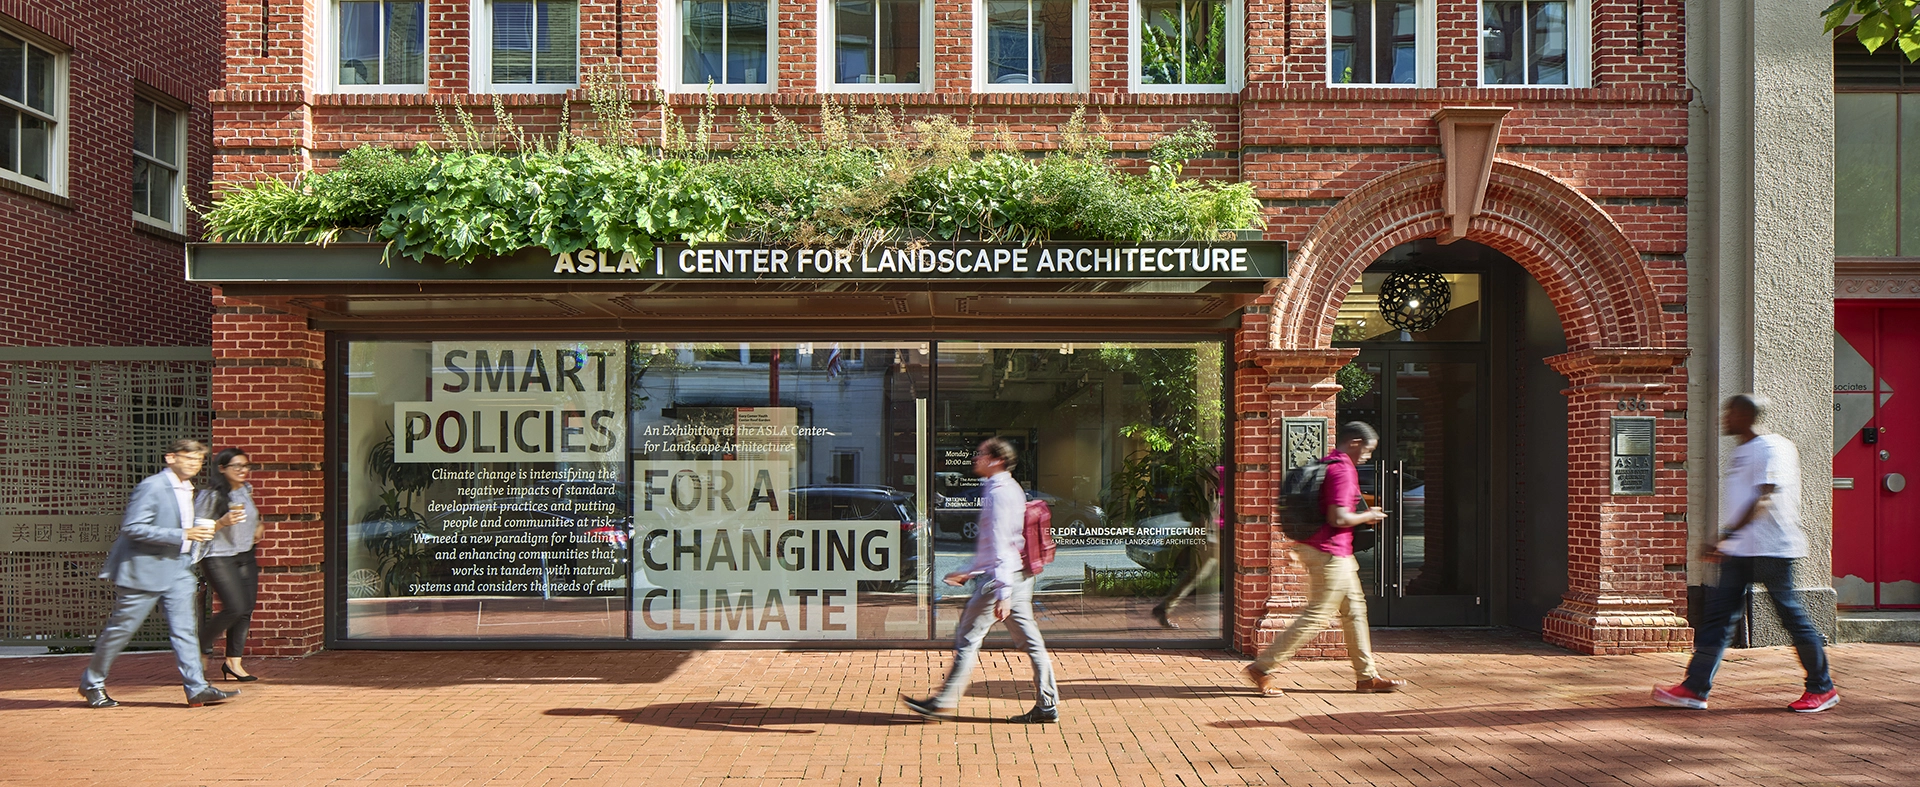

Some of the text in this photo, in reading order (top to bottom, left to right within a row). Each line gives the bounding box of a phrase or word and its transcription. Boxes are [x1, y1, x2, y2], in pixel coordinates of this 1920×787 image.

[553, 247, 1248, 274] ASLA CENTER FOR LANDSCAPE ARCHITECTURE
[443, 349, 616, 393] SMART
[1834, 382, 1867, 390] sociates
[1617, 396, 1647, 411] 636
[405, 409, 617, 454] POLICIES
[643, 424, 828, 436] An Exhibition at the ASLA Center
[643, 440, 660, 455] for
[662, 441, 720, 455] Landscape
[722, 440, 791, 452] Architecture
[945, 450, 969, 458] Monday
[1615, 457, 1650, 468] ASLA
[432, 467, 616, 483] Climate change is intensifying the
[457, 483, 616, 499] negative impacts of standard
[645, 469, 780, 511] FOR A
[428, 500, 616, 514] development practices and putting
[443, 516, 615, 531] people and communities at risk.
[1058, 527, 1077, 536] FOR
[1079, 527, 1135, 536] LANDSCAPE
[1136, 527, 1206, 536] ARCHITECTURE
[413, 531, 615, 547] We need a new paradigm for building
[435, 547, 615, 563] and enhancing communities that
[642, 528, 890, 571] CHANGING
[451, 564, 615, 576] works in tandem with natural
[409, 579, 615, 595] systems and considers the needs of all.
[642, 589, 847, 631] CLIMATE
